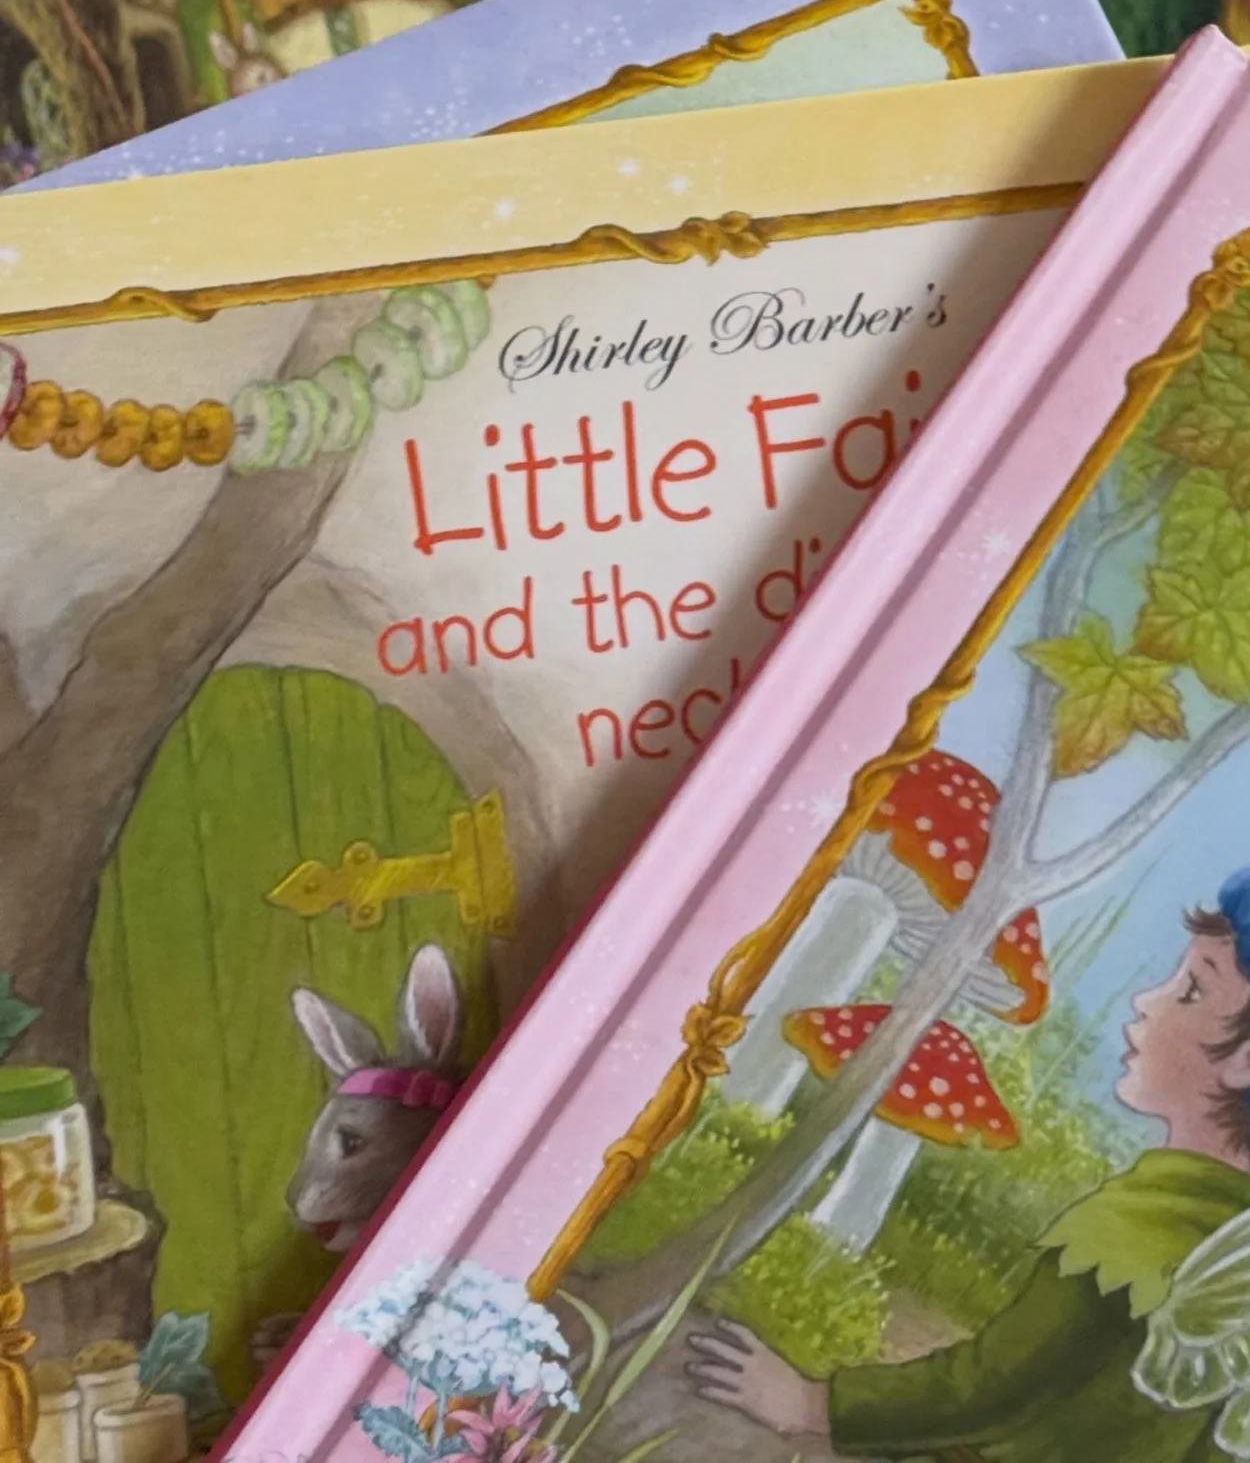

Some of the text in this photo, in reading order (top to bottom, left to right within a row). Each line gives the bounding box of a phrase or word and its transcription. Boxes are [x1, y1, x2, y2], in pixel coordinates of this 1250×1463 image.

[498, 282, 948, 394] Shirley Barber's
[404, 400, 717, 556] Little
[376, 575, 534, 676] and
[572, 564, 717, 654] the
